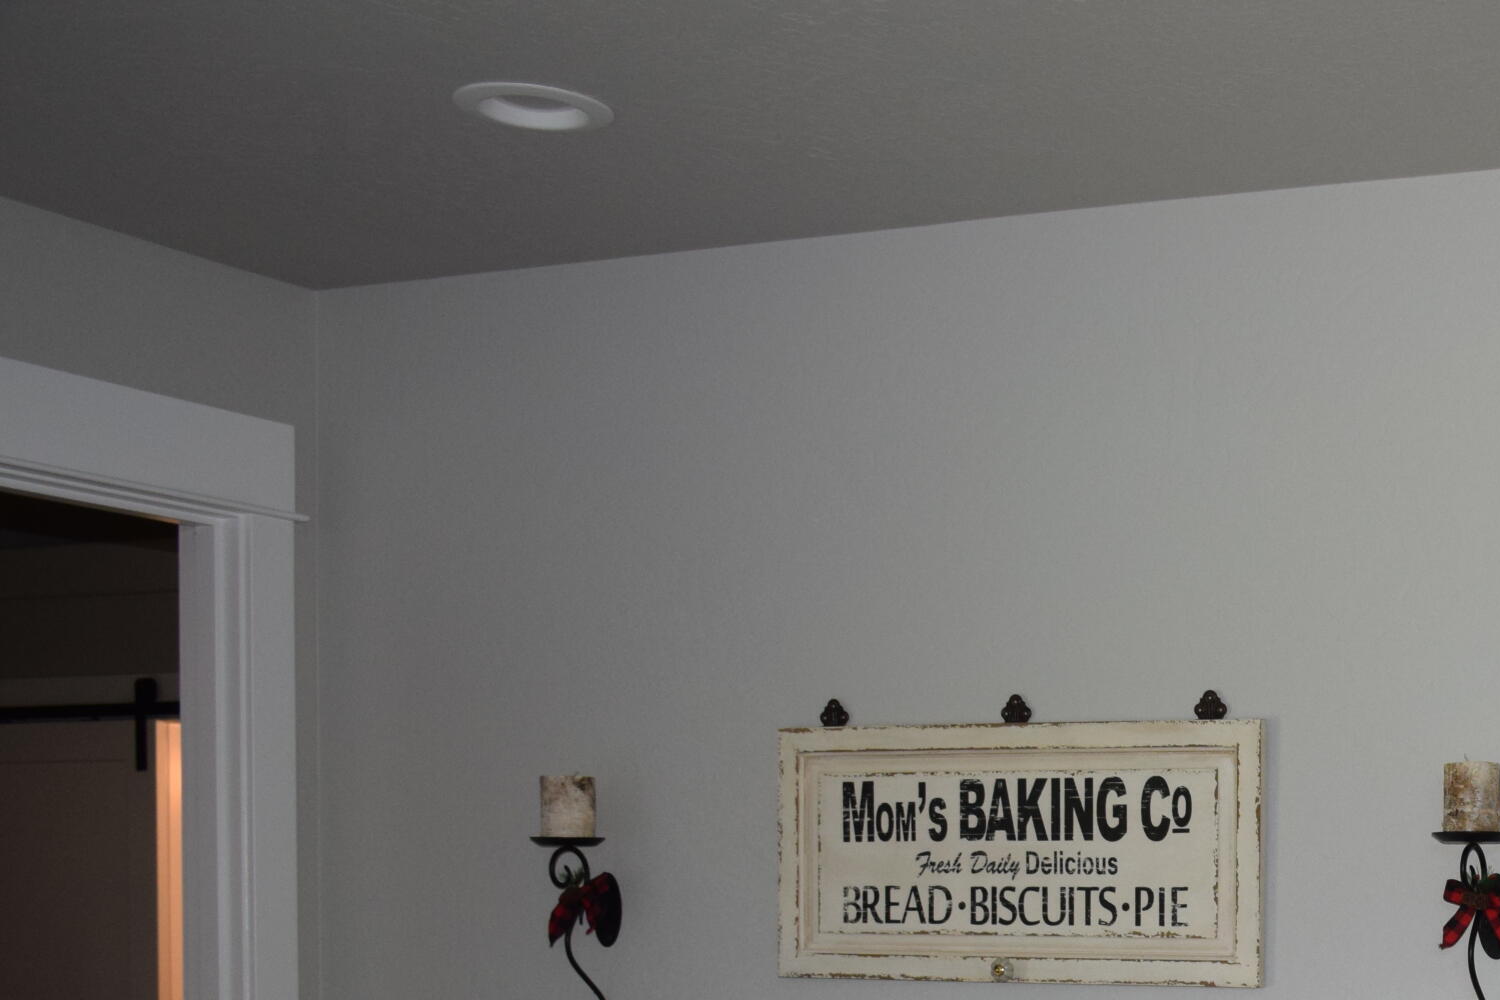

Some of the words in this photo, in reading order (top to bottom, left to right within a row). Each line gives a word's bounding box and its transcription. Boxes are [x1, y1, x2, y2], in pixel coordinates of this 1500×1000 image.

[959, 776, 1128, 842] BAKING
[915, 850, 963, 878] Fresh
[969, 850, 1021, 880] Daily
[1025, 850, 1119, 876] Delicious
[842, 884, 953, 925] BREAD
[970, 885, 1118, 927] BISCUITS
[1134, 886, 1189, 927] PIE
